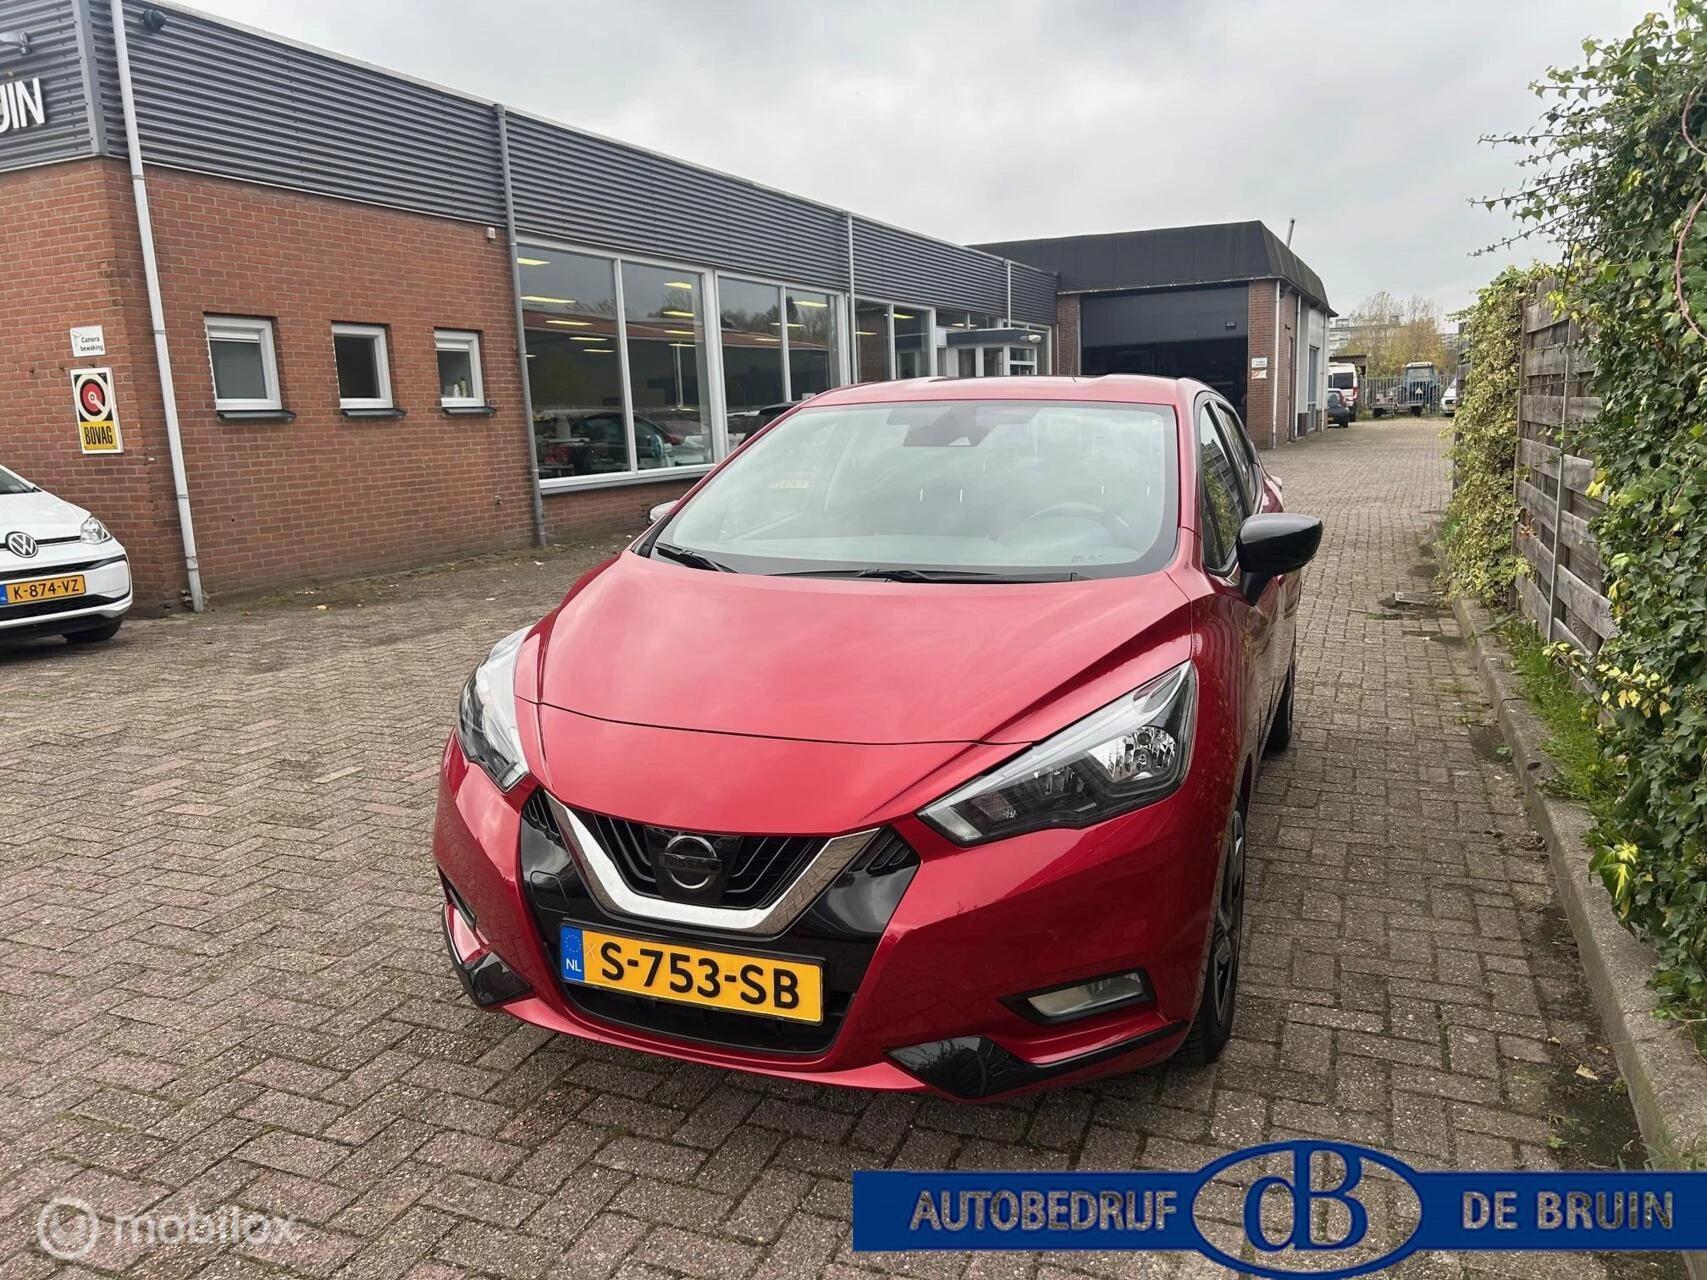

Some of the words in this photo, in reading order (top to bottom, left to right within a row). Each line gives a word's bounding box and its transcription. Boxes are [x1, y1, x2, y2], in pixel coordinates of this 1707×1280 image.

[84, 425, 113, 445] BOVAG
[13, 578, 79, 600] K-874-VZ
[566, 958, 582, 973] NL
[600, 941, 800, 1010] S-753-SB
